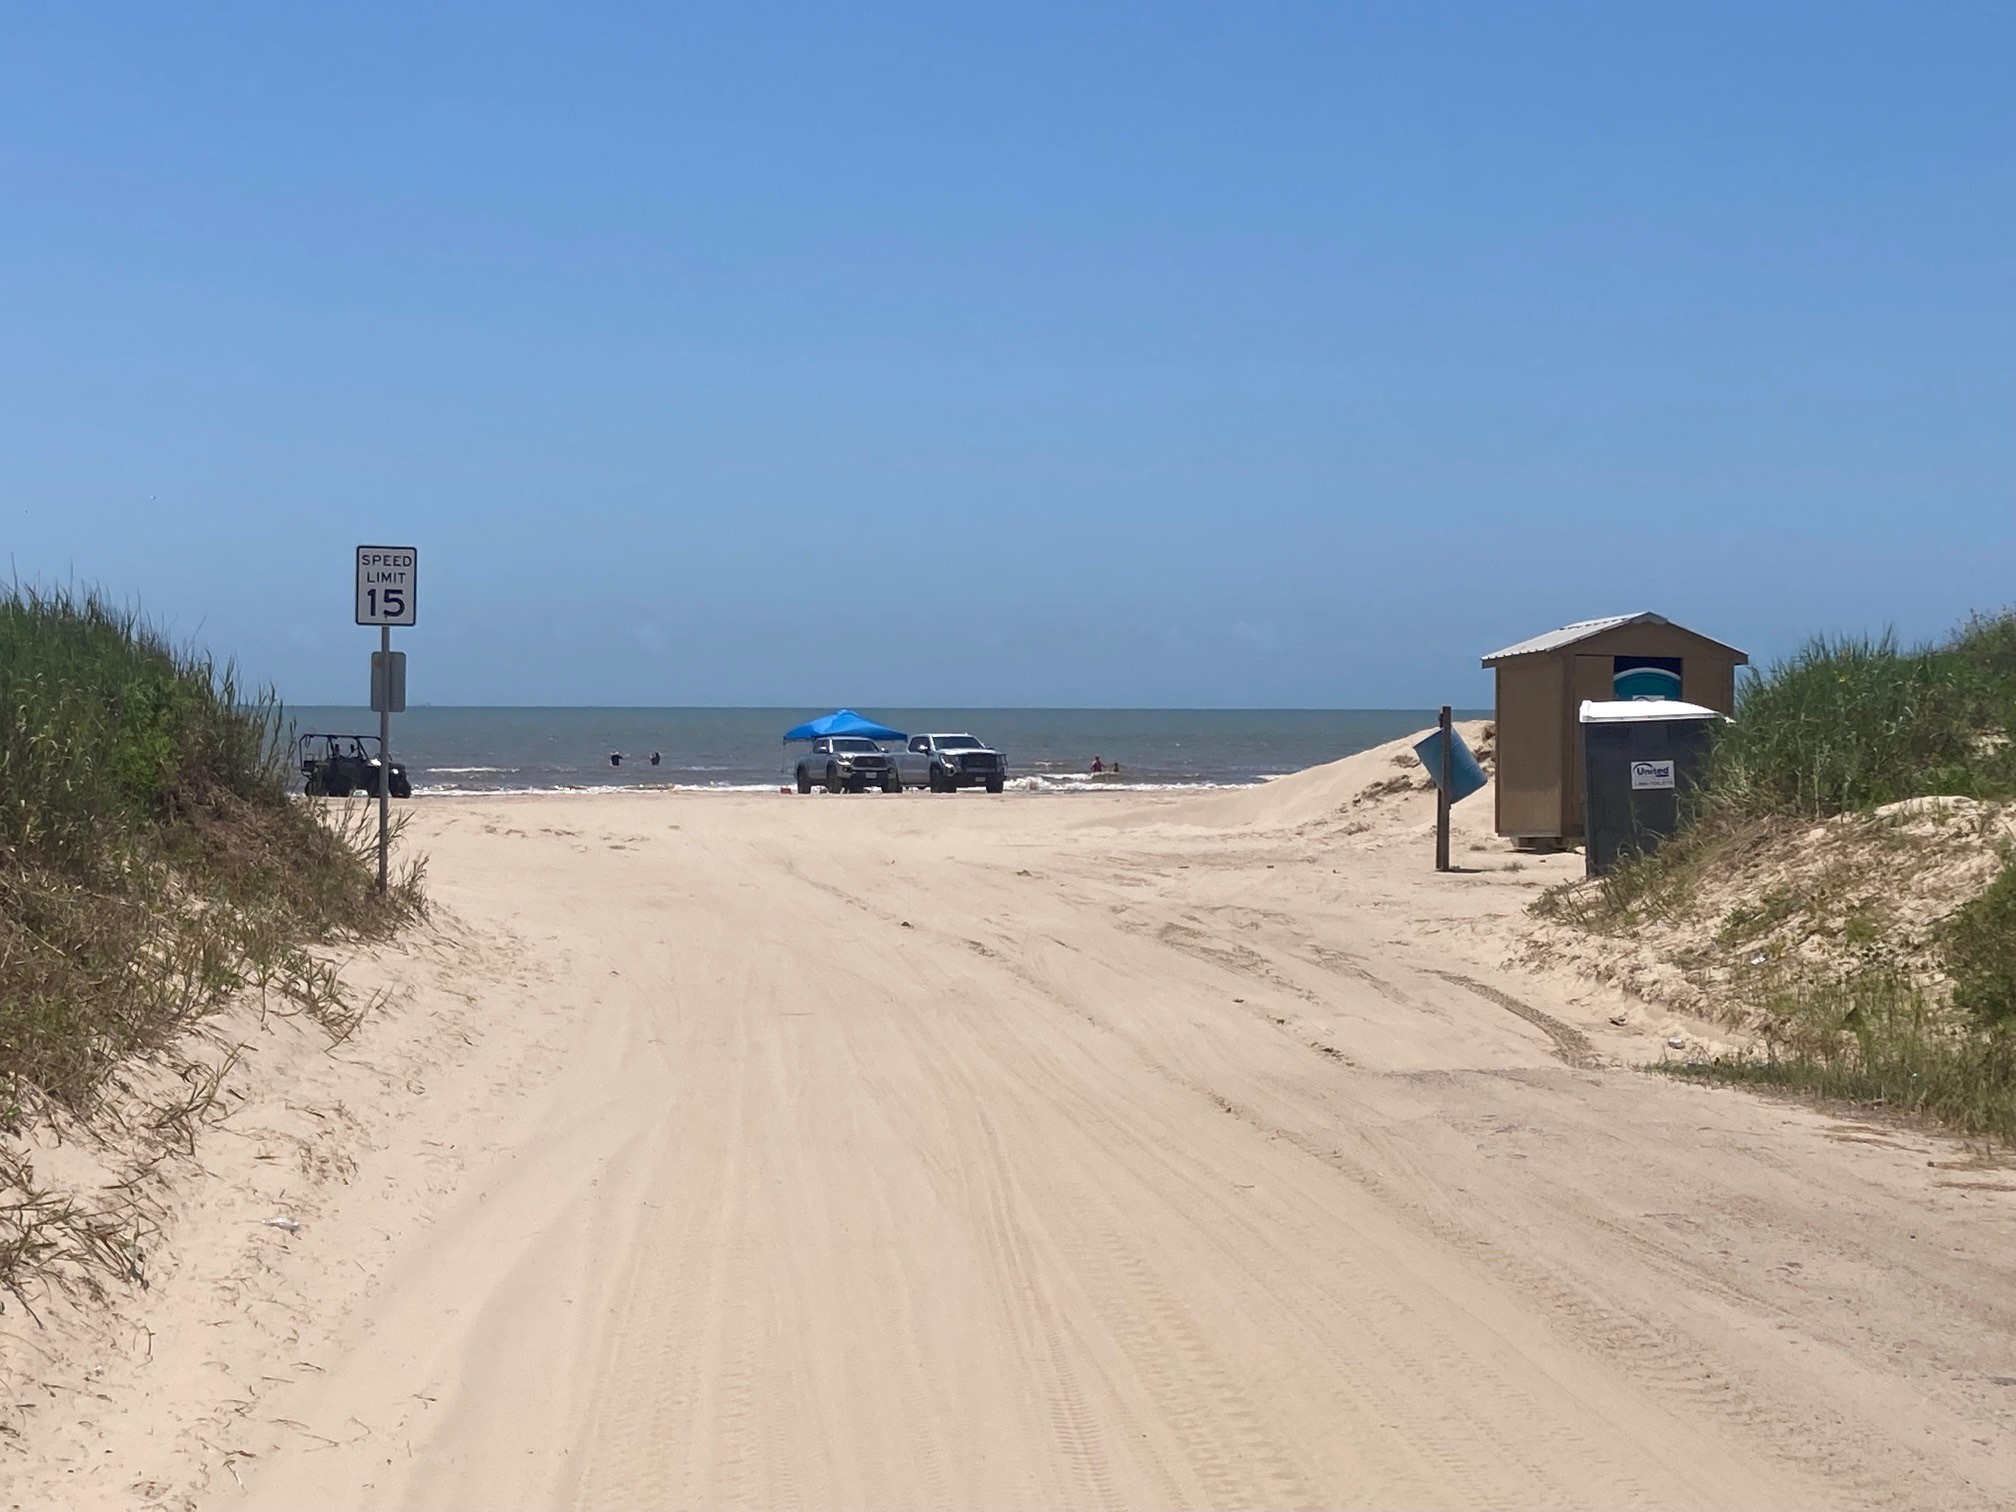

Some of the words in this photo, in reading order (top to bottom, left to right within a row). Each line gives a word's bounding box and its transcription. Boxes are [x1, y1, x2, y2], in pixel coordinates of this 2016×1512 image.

[361, 554, 412, 567] SPEED
[366, 571, 406, 584] LIMIT
[367, 588, 406, 617] 15
[1637, 766, 1669, 776] United
